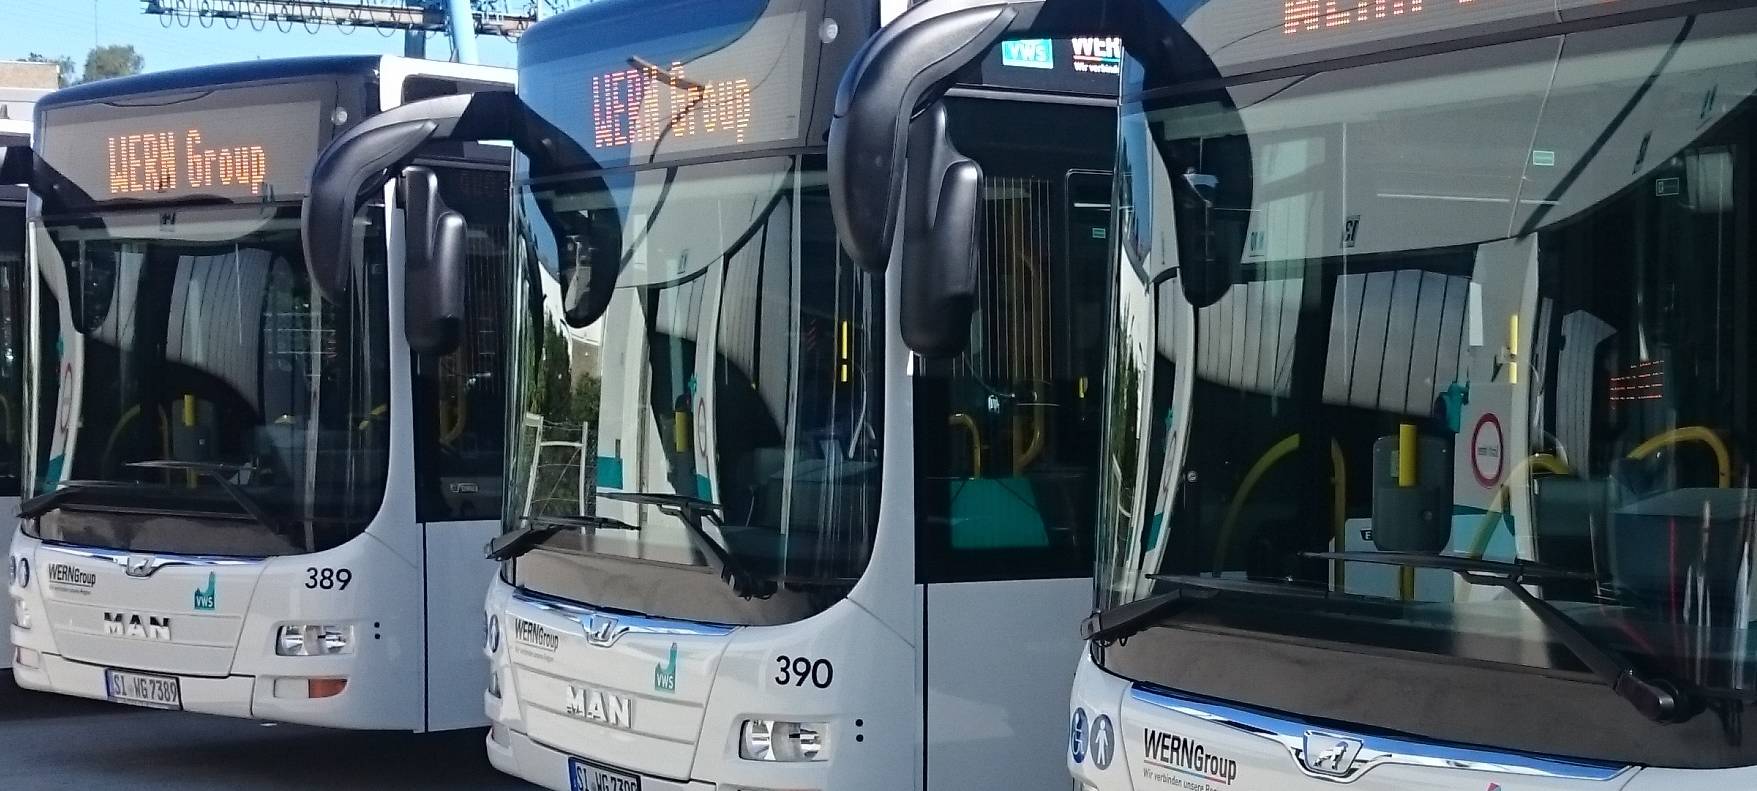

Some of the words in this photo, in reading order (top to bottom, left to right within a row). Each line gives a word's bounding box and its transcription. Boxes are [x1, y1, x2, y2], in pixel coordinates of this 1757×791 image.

[1072, 37, 1121, 57] WER
[592, 65, 660, 149] WERN
[669, 61, 750, 144] Group
[108, 131, 177, 194] WERN
[186, 129, 266, 194] Group
[49, 564, 96, 588] WERNGroup
[305, 567, 353, 591] 389
[195, 595, 214, 608] VWS
[103, 611, 172, 641] MAN
[515, 618, 559, 652] WERNGroup
[656, 673, 674, 689] VWS
[775, 655, 834, 689] 390
[113, 674, 127, 696] SI
[149, 678, 177, 702] 7389
[566, 684, 633, 729] MAN
[1144, 727, 1237, 786] WERNGroup
[577, 765, 589, 791] SI
[1143, 768, 1153, 779] Wir
[1154, 772, 1181, 786] verbinden
[1183, 780, 1204, 791] unsere
